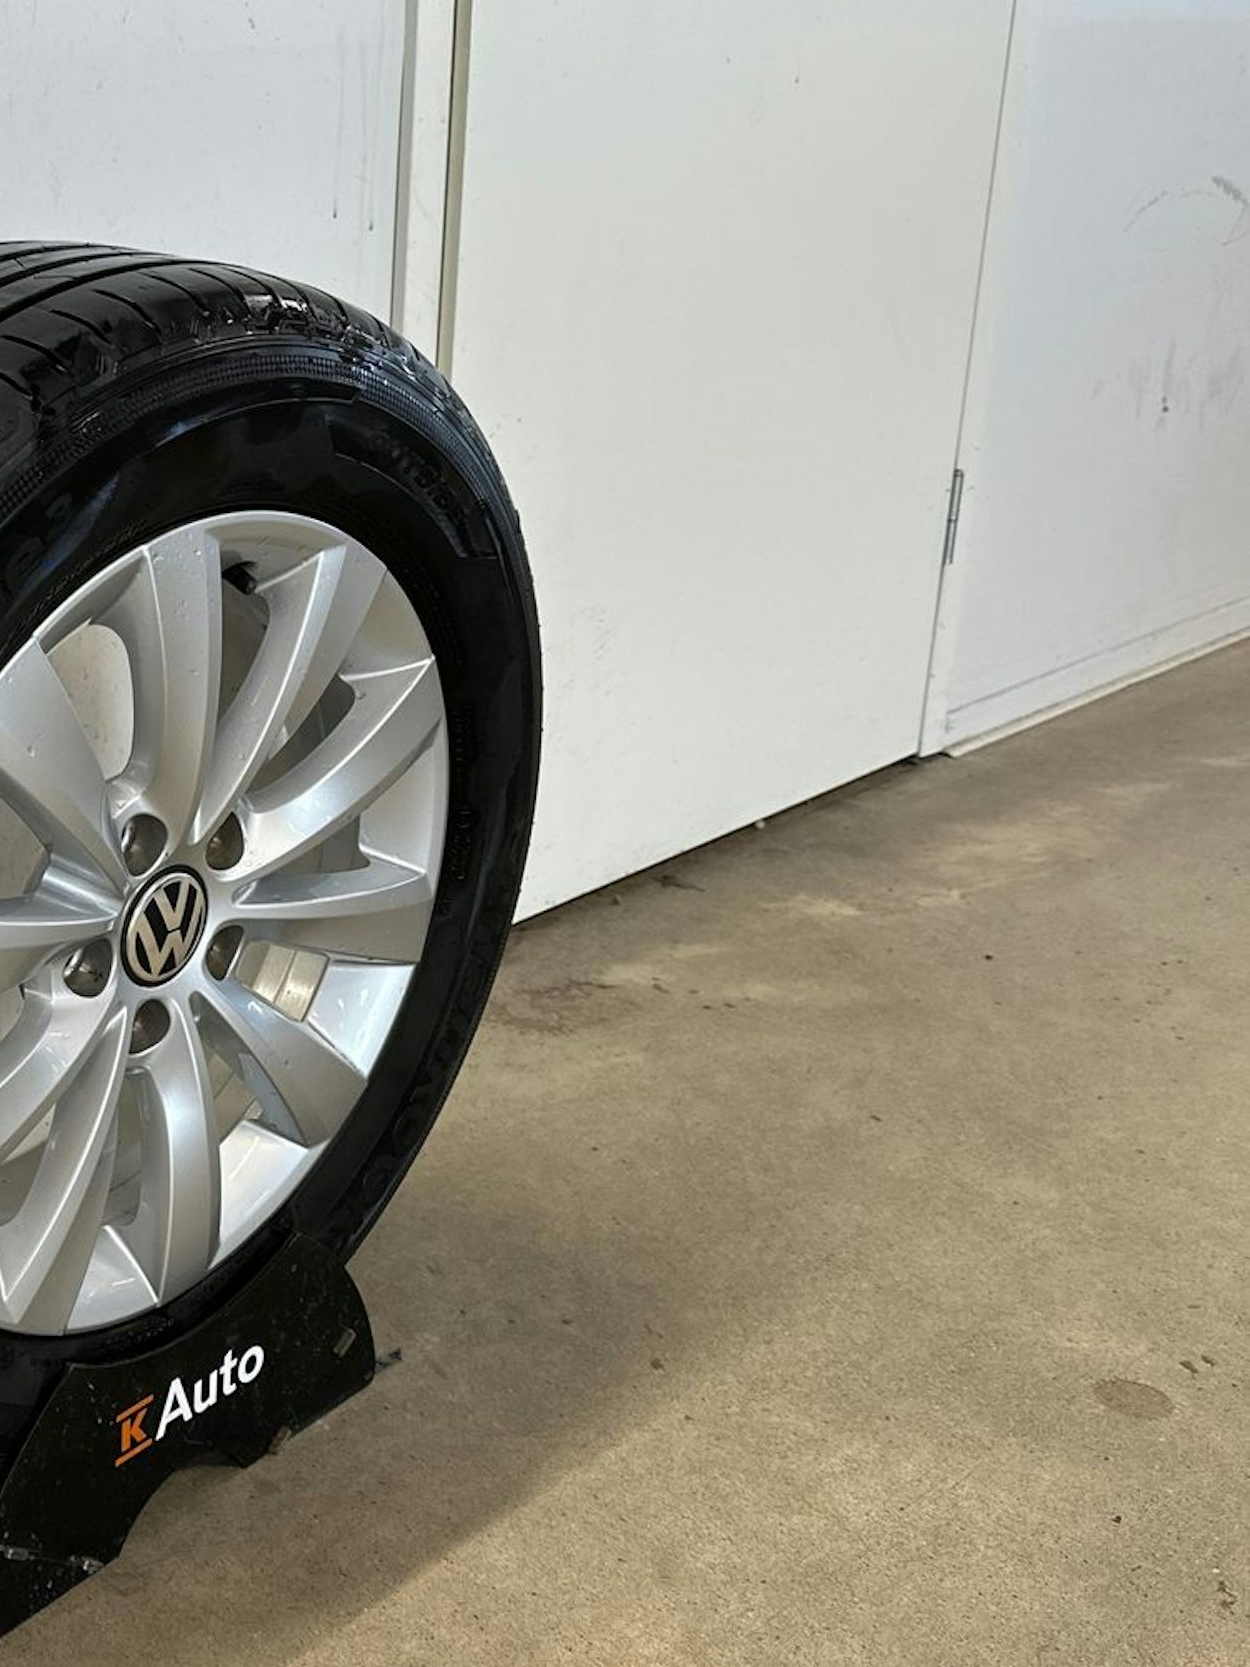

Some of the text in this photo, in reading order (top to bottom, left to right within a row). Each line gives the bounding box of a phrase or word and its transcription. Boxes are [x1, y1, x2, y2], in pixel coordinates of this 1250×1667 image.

[126, 871, 207, 983] VW
[118, 1345, 265, 1458] K Auto
